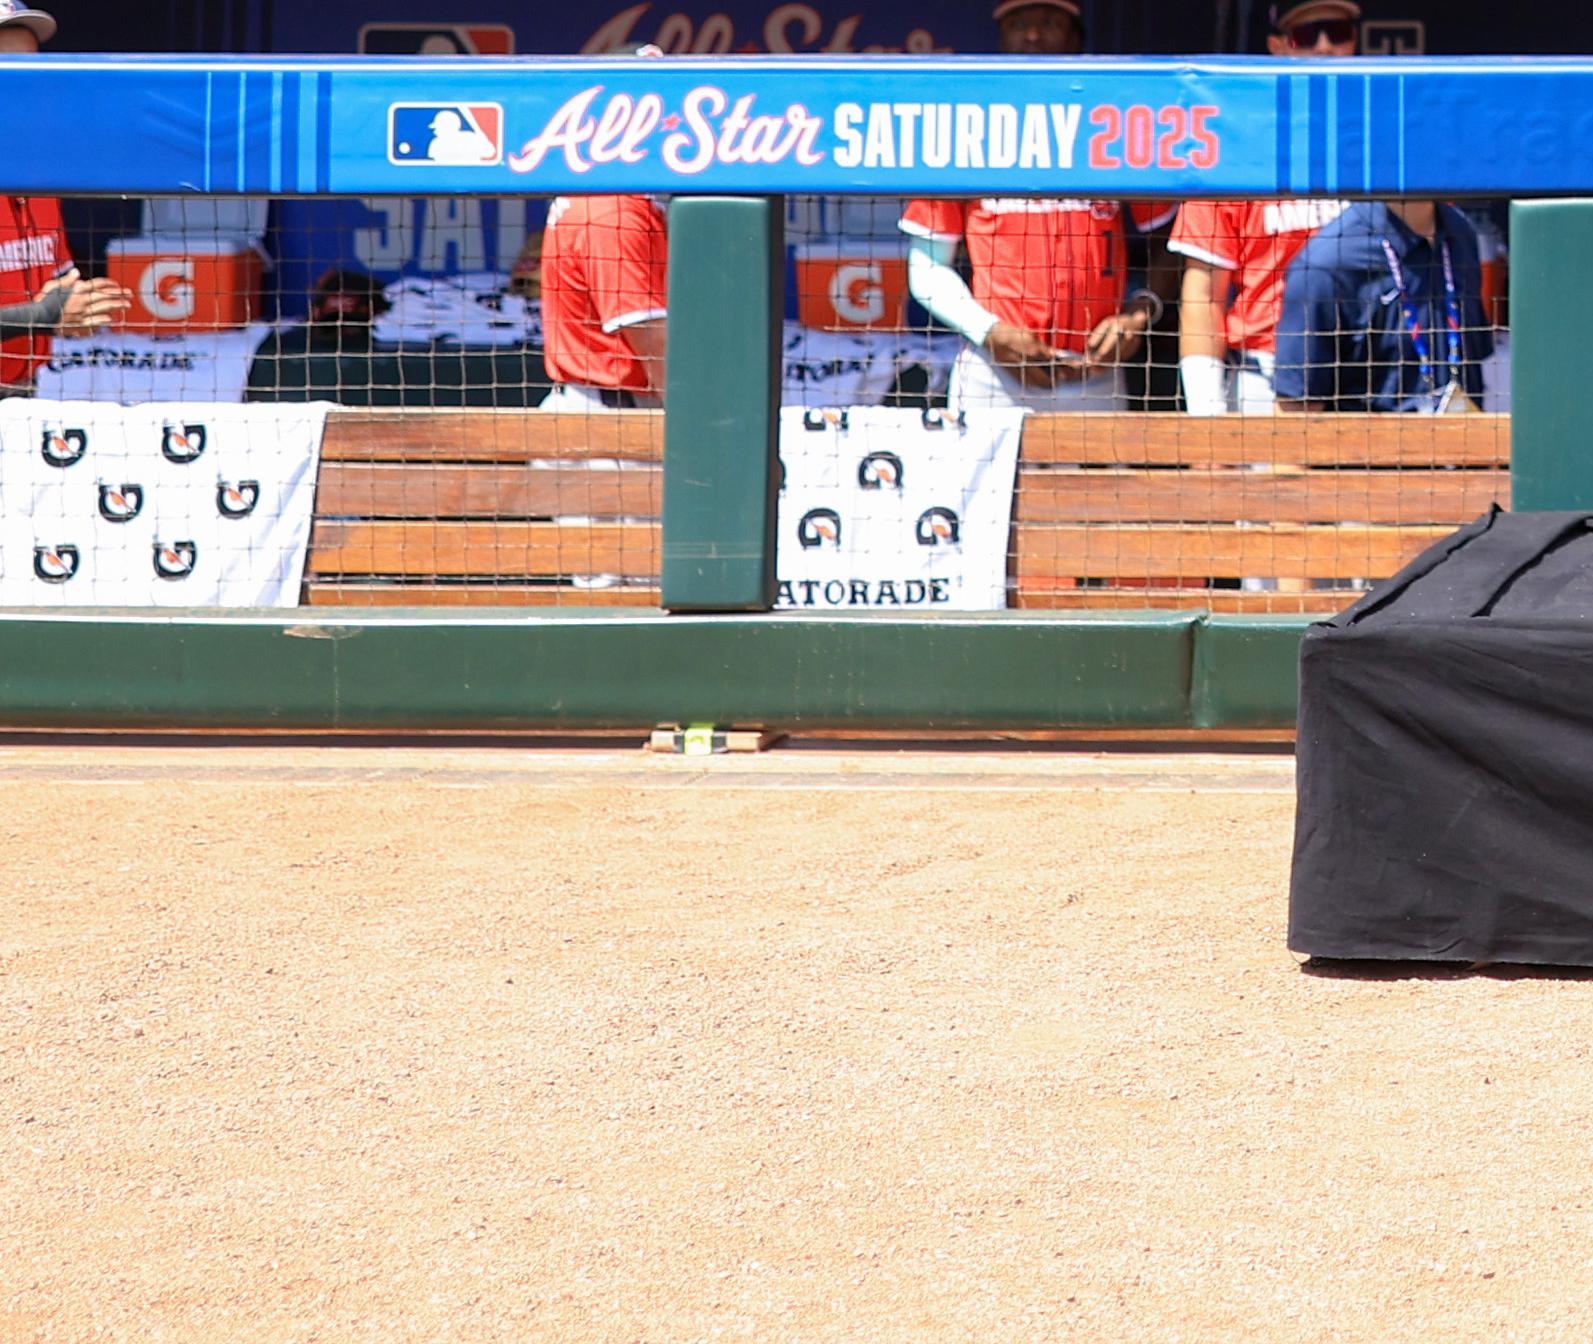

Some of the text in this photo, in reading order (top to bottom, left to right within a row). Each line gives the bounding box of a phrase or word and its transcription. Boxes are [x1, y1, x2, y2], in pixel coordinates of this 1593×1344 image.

[833, 102, 1083, 170] SATURDAY
[1089, 104, 1221, 170] 2025
[139, 256, 196, 321] G
[828, 264, 885, 323] G
[775, 577, 950, 606] ATORADE
